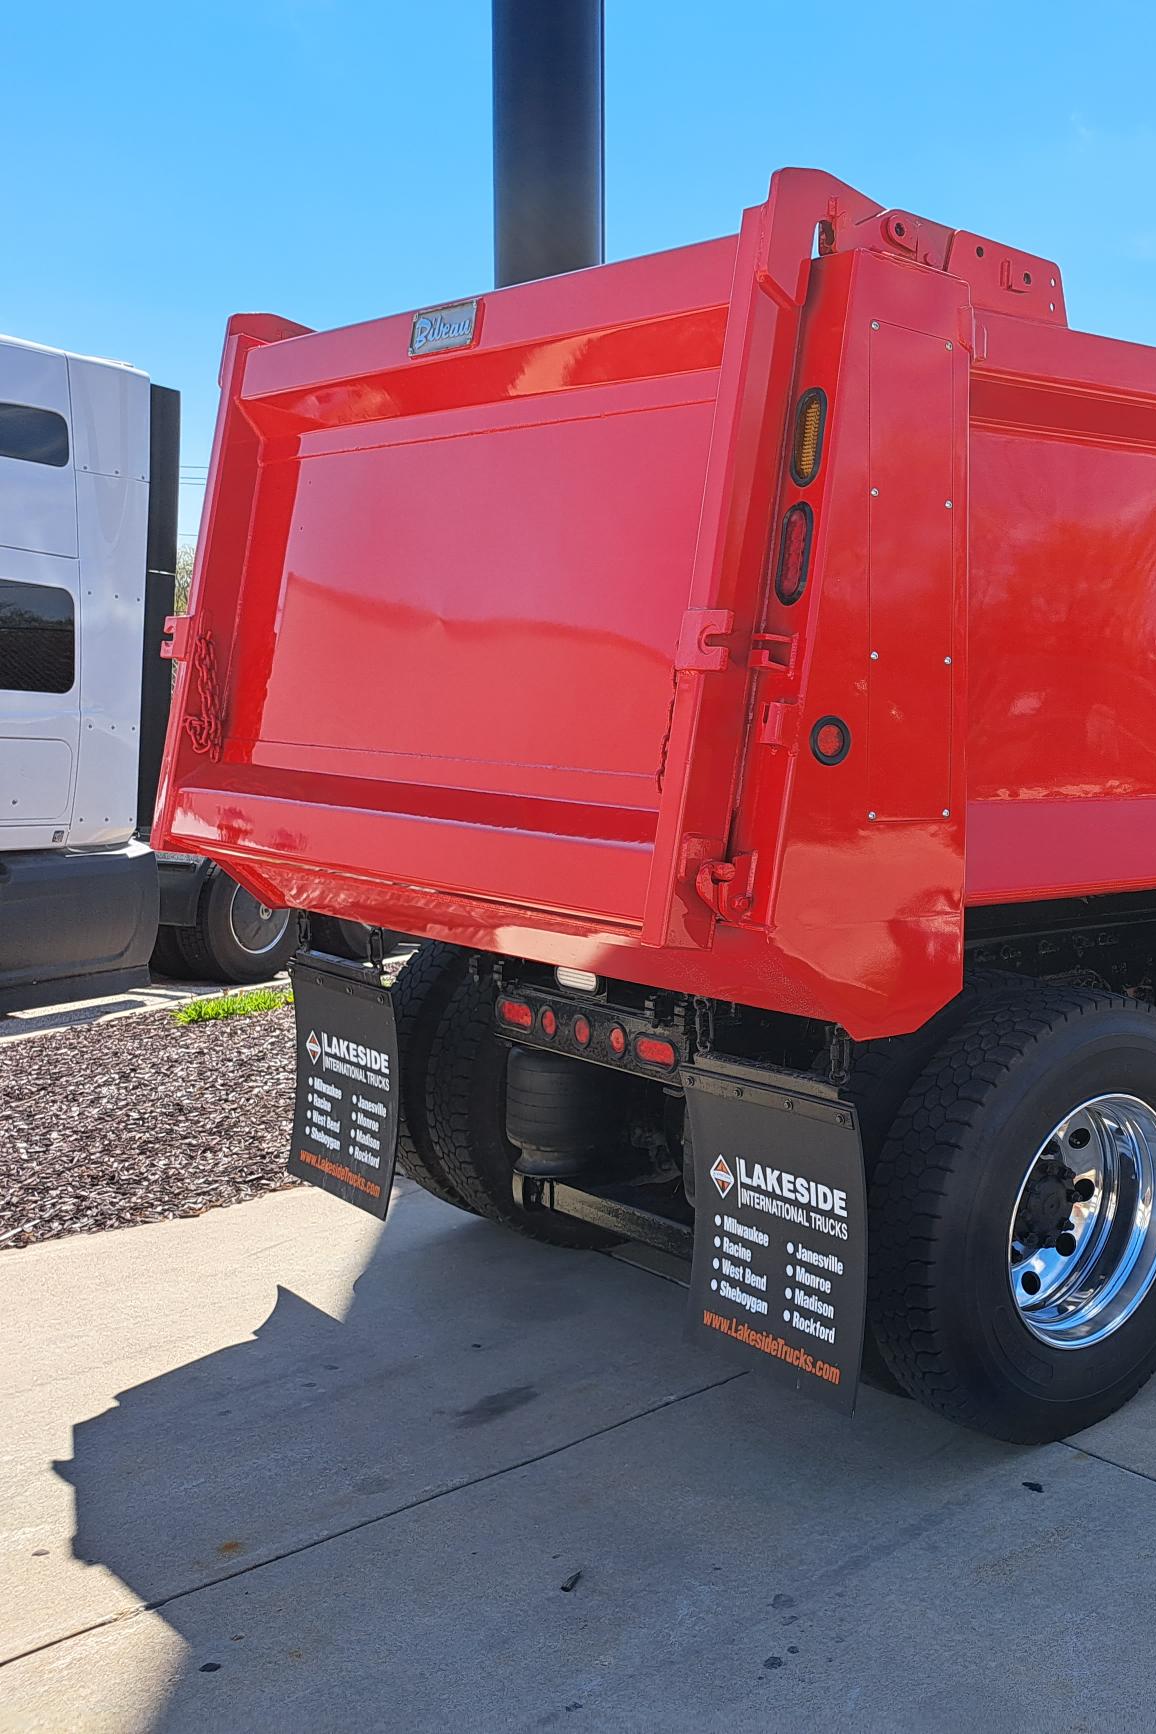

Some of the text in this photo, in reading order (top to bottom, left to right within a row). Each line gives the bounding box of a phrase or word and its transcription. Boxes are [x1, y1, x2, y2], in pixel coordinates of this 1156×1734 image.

[414, 315, 472, 350] Bibeau
[324, 1032, 390, 1075] LAKESIDE
[313, 1077, 342, 1100] Milwaukee
[325, 1055, 390, 1092] INTERNATIONAL TRUCKS
[313, 1093, 332, 1112] Racine
[357, 1095, 387, 1118] Janesville
[312, 1109, 341, 1133] West Bend
[357, 1111, 379, 1132] Monroe
[310, 1126, 341, 1151] Sheboygan
[356, 1129, 380, 1150] Madison
[354, 1145, 380, 1169] Rockford
[300, 1149, 381, 1198] www.LakesideTrucks.com
[739, 1158, 848, 1218] LAKESIDE
[741, 1188, 848, 1241] INTERNATIONAL TRUCKS
[723, 1215, 769, 1247] Milwaukee
[722, 1236, 752, 1263] Racine
[796, 1243, 844, 1275] Janesville
[721, 1258, 767, 1292] West Bend
[795, 1265, 831, 1294] Monroe
[719, 1280, 769, 1315] Sheboygan
[794, 1288, 835, 1320] Madison
[792, 1310, 836, 1344] Rockford
[703, 1309, 841, 1385] www.LakesideTrucks.com
